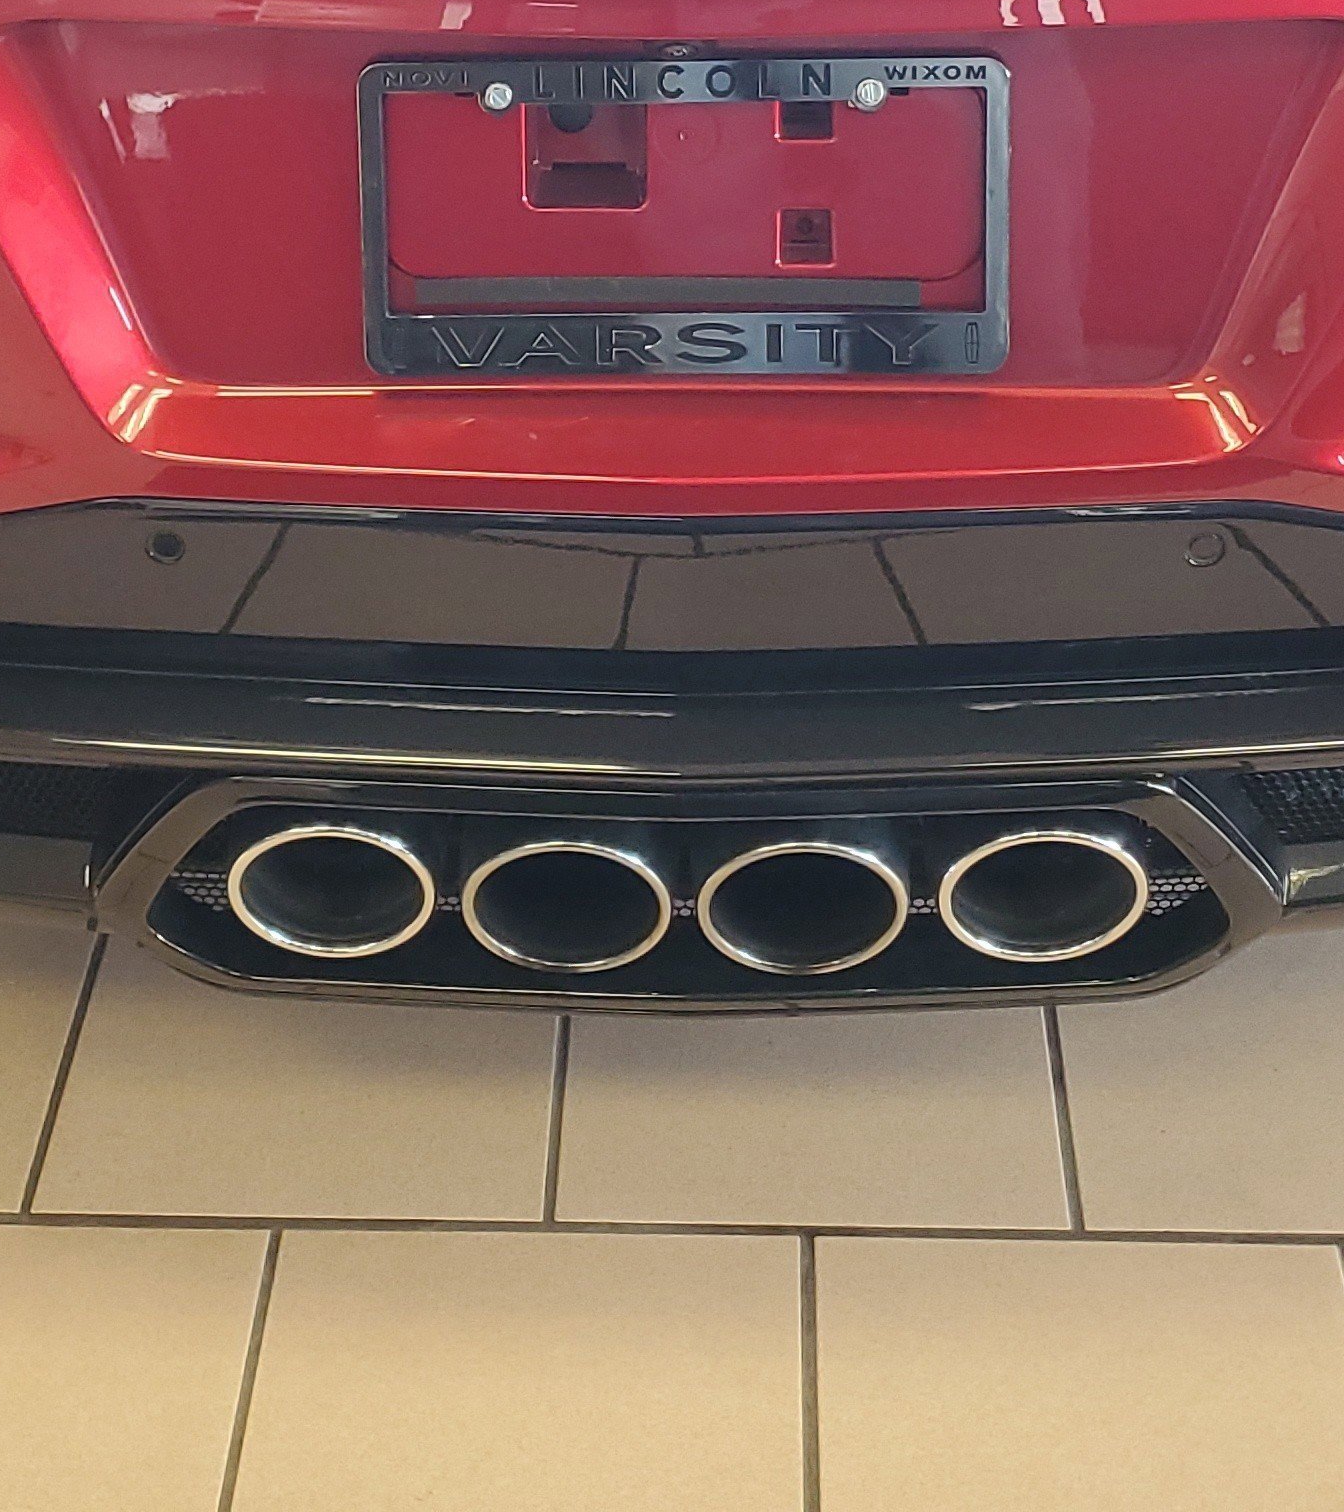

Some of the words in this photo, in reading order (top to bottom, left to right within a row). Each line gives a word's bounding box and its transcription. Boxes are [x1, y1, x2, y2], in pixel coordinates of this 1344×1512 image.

[382, 69, 470, 87] NOVI
[532, 63, 833, 100] LINCOLN
[883, 64, 988, 81] WIXOM
[430, 322, 941, 367] VARSITY
